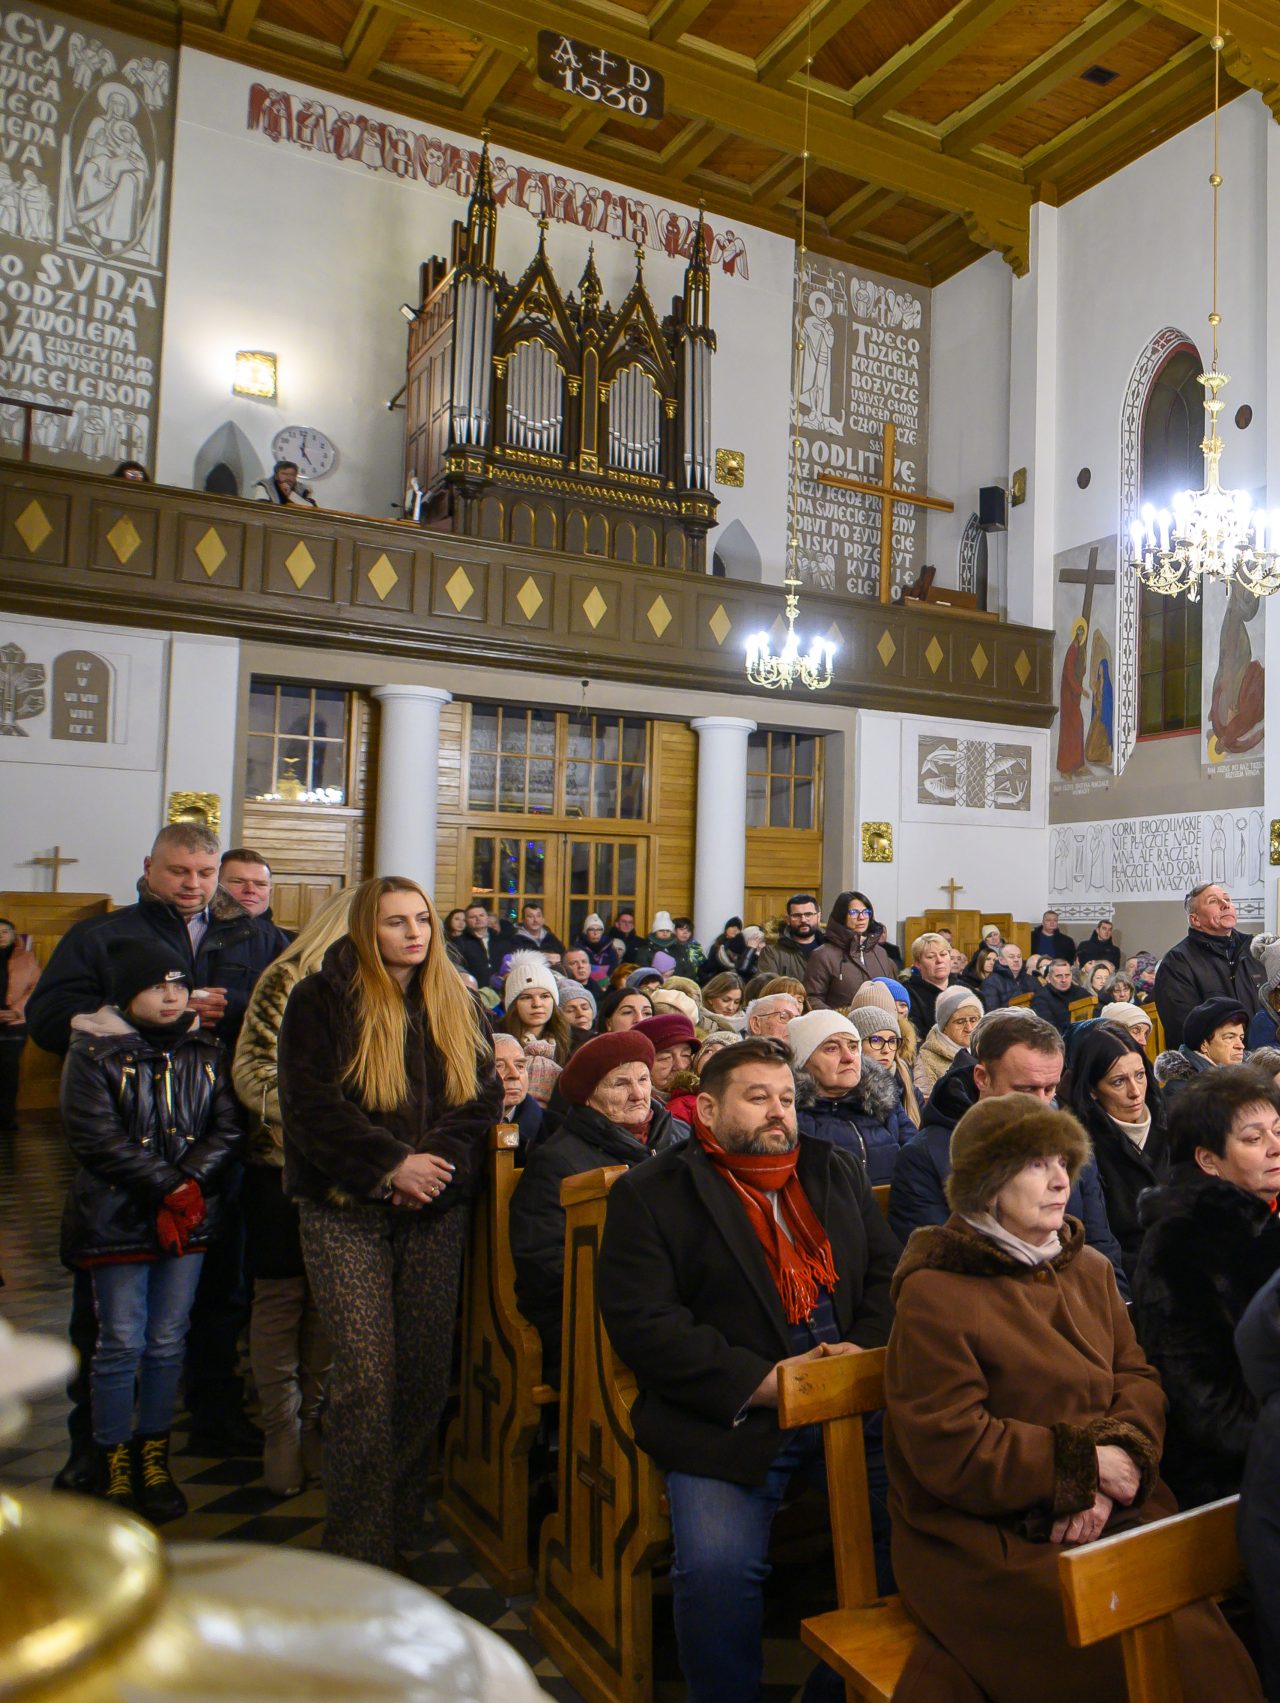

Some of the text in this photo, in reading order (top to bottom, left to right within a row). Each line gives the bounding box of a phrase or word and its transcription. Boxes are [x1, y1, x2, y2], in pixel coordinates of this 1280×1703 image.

[626, 59, 651, 91] D
[558, 66, 648, 116] 1530
[0, 278, 137, 328] ODZINA
[831, 521, 850, 539] PO
[852, 525, 915, 552] ŻYWCIE
[844, 541, 913, 568] PRZEYT
[1111, 836, 1128, 851] NIE
[1174, 830, 1202, 847] NADE
[1138, 848, 1153, 863] ALE
[1156, 845, 1193, 862] RACZEJ
[1152, 861, 1174, 877] NAD
